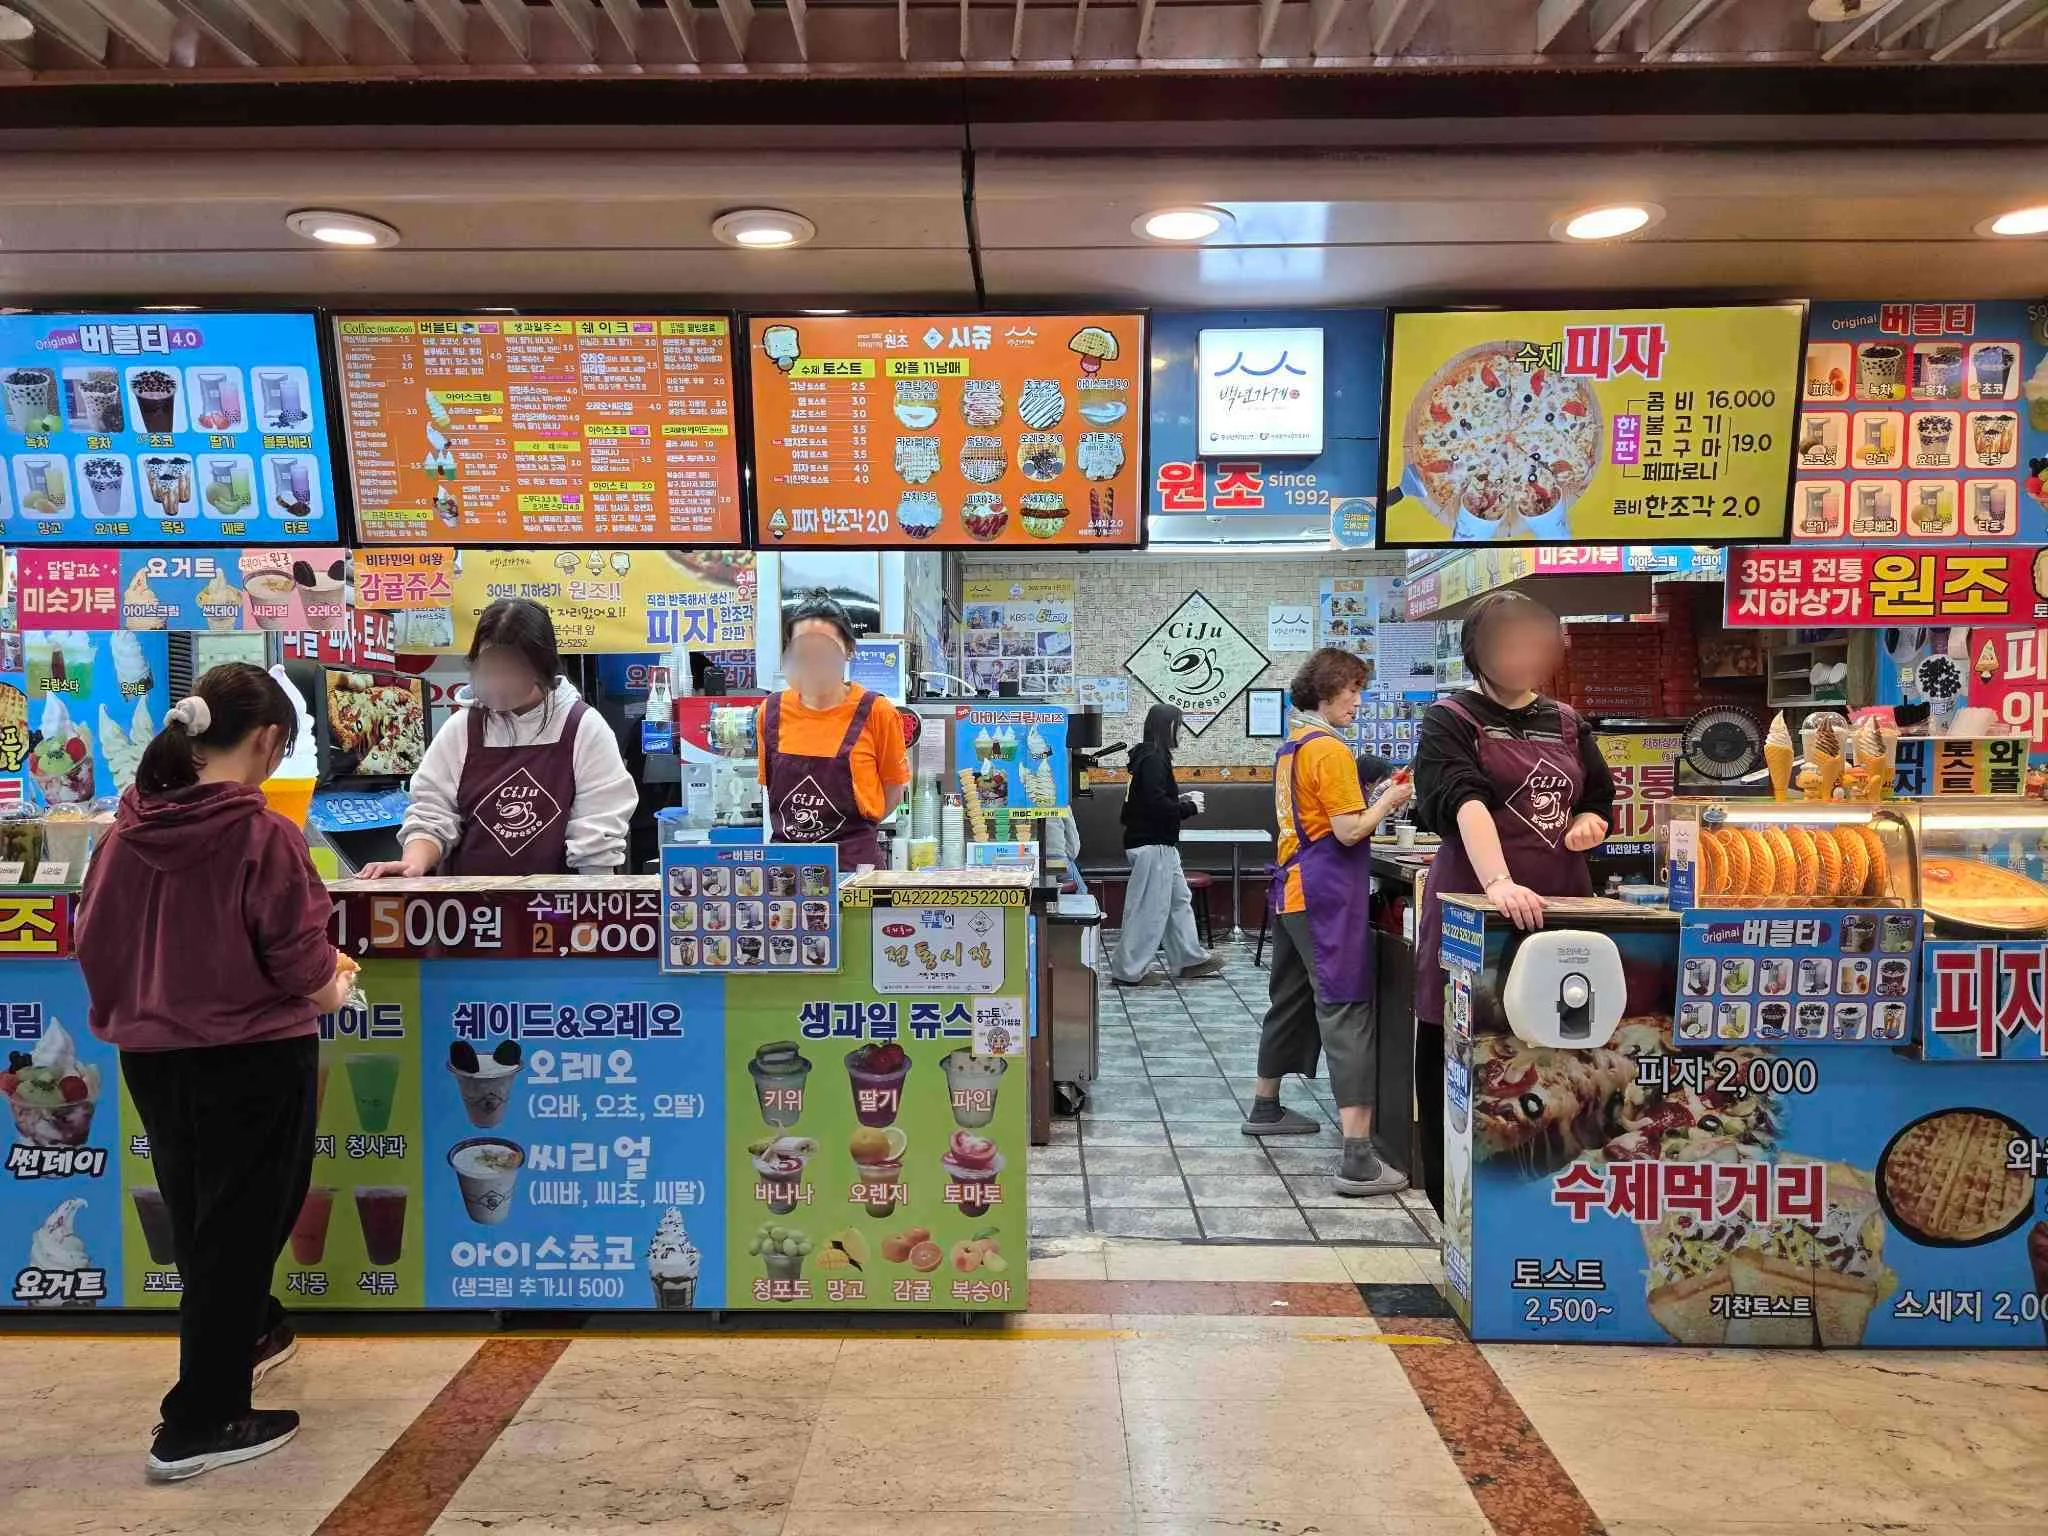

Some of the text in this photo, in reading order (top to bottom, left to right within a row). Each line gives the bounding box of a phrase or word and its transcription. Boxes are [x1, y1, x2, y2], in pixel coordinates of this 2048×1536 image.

[420, 322, 458, 334] 버블티
[1832, 303, 1975, 336] Original 버블티
[35, 324, 197, 355] Original 버블티 4.0
[884, 332, 909, 349] 원조
[948, 324, 992, 350] 시쥬
[1515, 323, 1667, 381] 수제 피자
[801, 361, 863, 375] 수제 토스트
[894, 360, 961, 374] 와플 11남매
[1869, 383, 1891, 396] 녹차
[1925, 384, 1948, 396] 홍차
[1981, 383, 2004, 396] 초코
[1647, 391, 1694, 411] 콤비
[1646, 414, 1722, 436] 불고기
[24, 435, 49, 449] 녹차
[149, 434, 175, 449] 초코
[208, 435, 236, 449] 딸기
[263, 435, 312, 450] 블루베리
[1019, 434, 1063, 444] 오레오 3.0
[1615, 416, 1639, 462] 한판
[1644, 437, 1722, 458] 고구마
[1732, 433, 1773, 453] 19.0
[1802, 453, 1837, 466] 코코넛
[1865, 453, 1890, 466] 망고
[1915, 454, 1951, 466] 요거트
[1642, 461, 1718, 482] 페파로니
[1156, 461, 1317, 512] 원조 since
[1284, 490, 1330, 506] 1992
[1613, 494, 1761, 519] 콤비 한조각 2.0
[37, 521, 64, 536] 망고
[95, 522, 130, 536] 요거트
[160, 521, 185, 534] 흑당
[283, 521, 310, 535] 타로
[791, 507, 888, 534] 피자 한조각 2.0
[1110, 519, 1124, 528] 2.0
[1806, 520, 1830, 533] 딸기
[1853, 520, 1898, 533] 블루베리
[1977, 520, 2002, 533] 타로
[146, 558, 217, 579] 요거트
[365, 553, 443, 566] 비타민의 여왕
[1627, 555, 1678, 567] 아이스크림
[47, 562, 101, 580] 달달고소
[359, 572, 451, 601] 감귤쥬스
[486, 583, 517, 598] 30년!
[520, 583, 561, 598] 지하상가
[1741, 554, 2010, 618] 35년 전통 원조
[23, 587, 117, 614] 미숫가루
[647, 593, 666, 606] 직접
[1738, 588, 1862, 617] 지하상가
[123, 604, 179, 618] 아이스크림
[202, 605, 239, 618] 썬데이
[253, 605, 288, 617] 씨리얼
[307, 605, 343, 617] 오레오
[646, 605, 753, 644] 피자 한조각
[1168, 620, 1222, 640] CiJu
[40, 678, 80, 692] 크림소다
[1168, 690, 1227, 710] espresso
[1940, 741, 1976, 793] 토스트
[1990, 740, 2024, 794] 와플
[500, 786, 539, 799] CiJu
[1530, 775, 1567, 790] CiJu
[792, 792, 825, 806] CiJu
[493, 819, 543, 839] Espresso
[527, 892, 661, 921] 수퍼사이즈
[843, 890, 873, 906] 하나
[331, 896, 503, 955] 1,500원
[1702, 919, 1820, 948] Original 버블티
[533, 922, 657, 958] 2,000
[884, 941, 992, 971] 전통시장
[452, 1000, 685, 1041] 쉐이드&오레오
[799, 1001, 973, 1041] 생과일 쥬스
[527, 1049, 637, 1084] 오레오
[1637, 1055, 1818, 1095] 피자 2,000
[528, 1094, 705, 1121] (오바, 오초, 오딸)
[763, 1088, 803, 1112] 키위
[857, 1088, 897, 1112] 딸기
[952, 1088, 992, 1112] 파인
[345, 1136, 407, 1158] 청사과
[527, 1135, 651, 1180] 씨리얼
[8, 1146, 107, 1179] 썬데이
[528, 1181, 706, 1208] (씨바, 씨초, 씨딸)
[754, 1182, 814, 1205] 바나나
[848, 1182, 909, 1205] 오렌지
[943, 1182, 1002, 1205] 토마토
[1552, 1160, 1829, 1226] 수제먹거리
[450, 1234, 636, 1271] 아이스초코
[14, 1269, 106, 1299] 요거트
[287, 1271, 328, 1295] 자몽
[357, 1271, 399, 1295] 석류
[1511, 1258, 1606, 1291] 토스트
[451, 1277, 624, 1299] (생크림 추가시 500)
[752, 1279, 813, 1302] 청포도
[826, 1279, 866, 1302] 망고
[893, 1279, 933, 1302] 감귤
[951, 1279, 1012, 1302] 복숭아
[1523, 1297, 1612, 1325] 2,500~
[1710, 1295, 1813, 1319] 기찬토스트
[1893, 1290, 1982, 1323] 소세지
